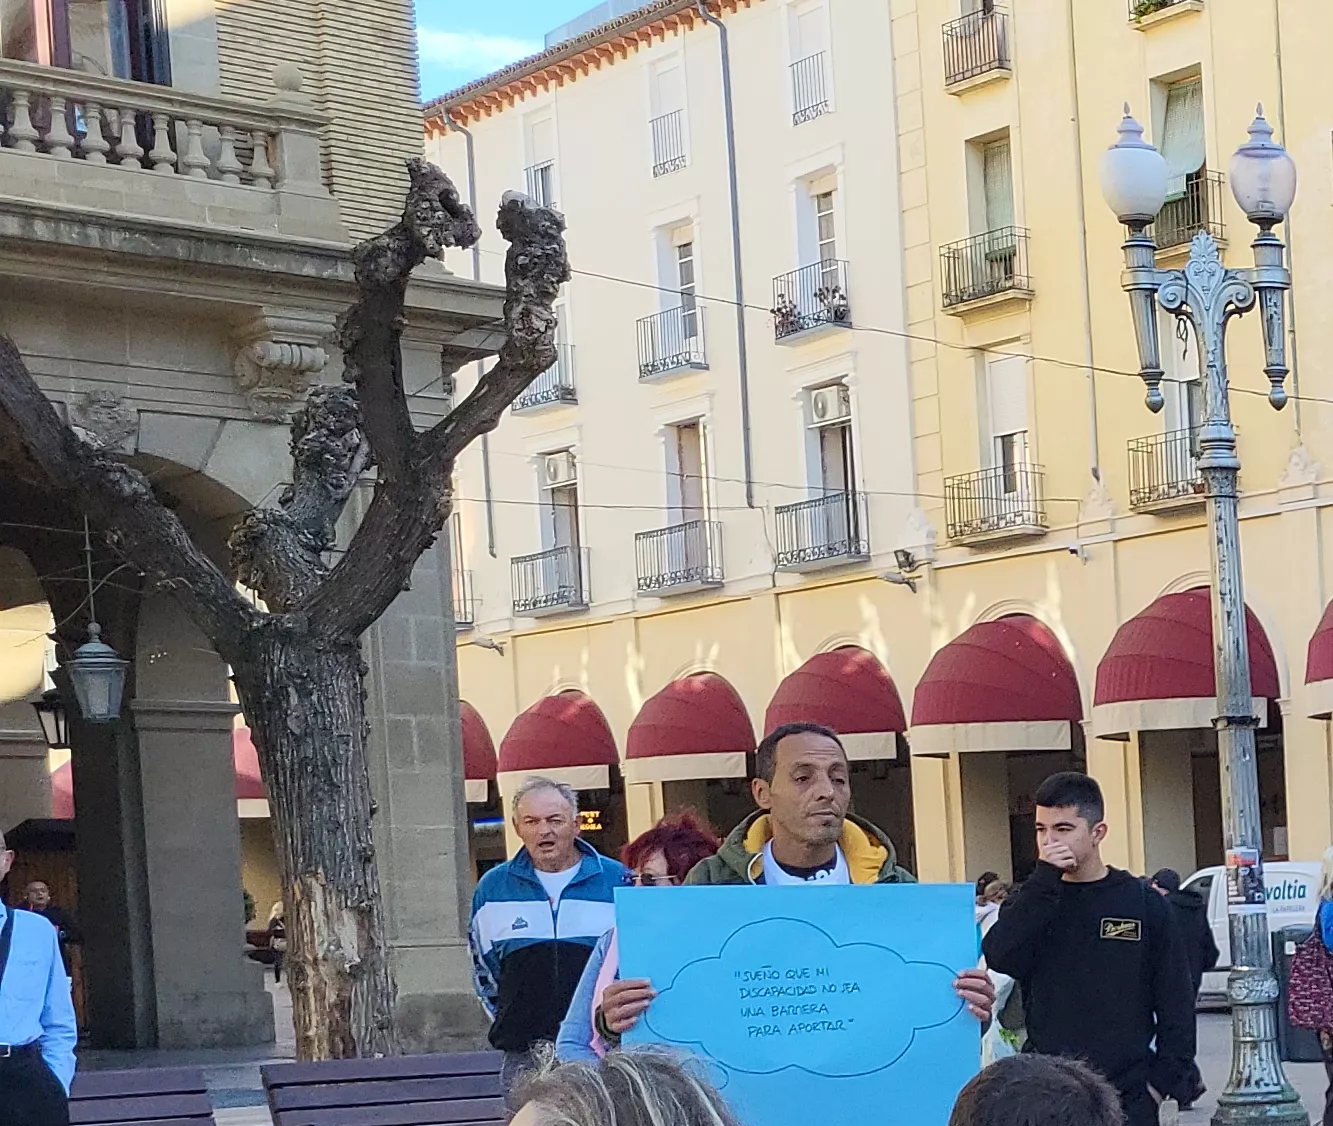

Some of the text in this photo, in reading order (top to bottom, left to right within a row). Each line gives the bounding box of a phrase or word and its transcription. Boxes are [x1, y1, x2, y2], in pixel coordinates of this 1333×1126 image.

[785, 968, 811, 980] QUE
[816, 968, 830, 977] MI
[739, 982, 862, 999] DISCAPACIDAD NO SEA
[740, 1003, 830, 1018] UNA BARRERA
[747, 1024, 782, 1038] PARA
